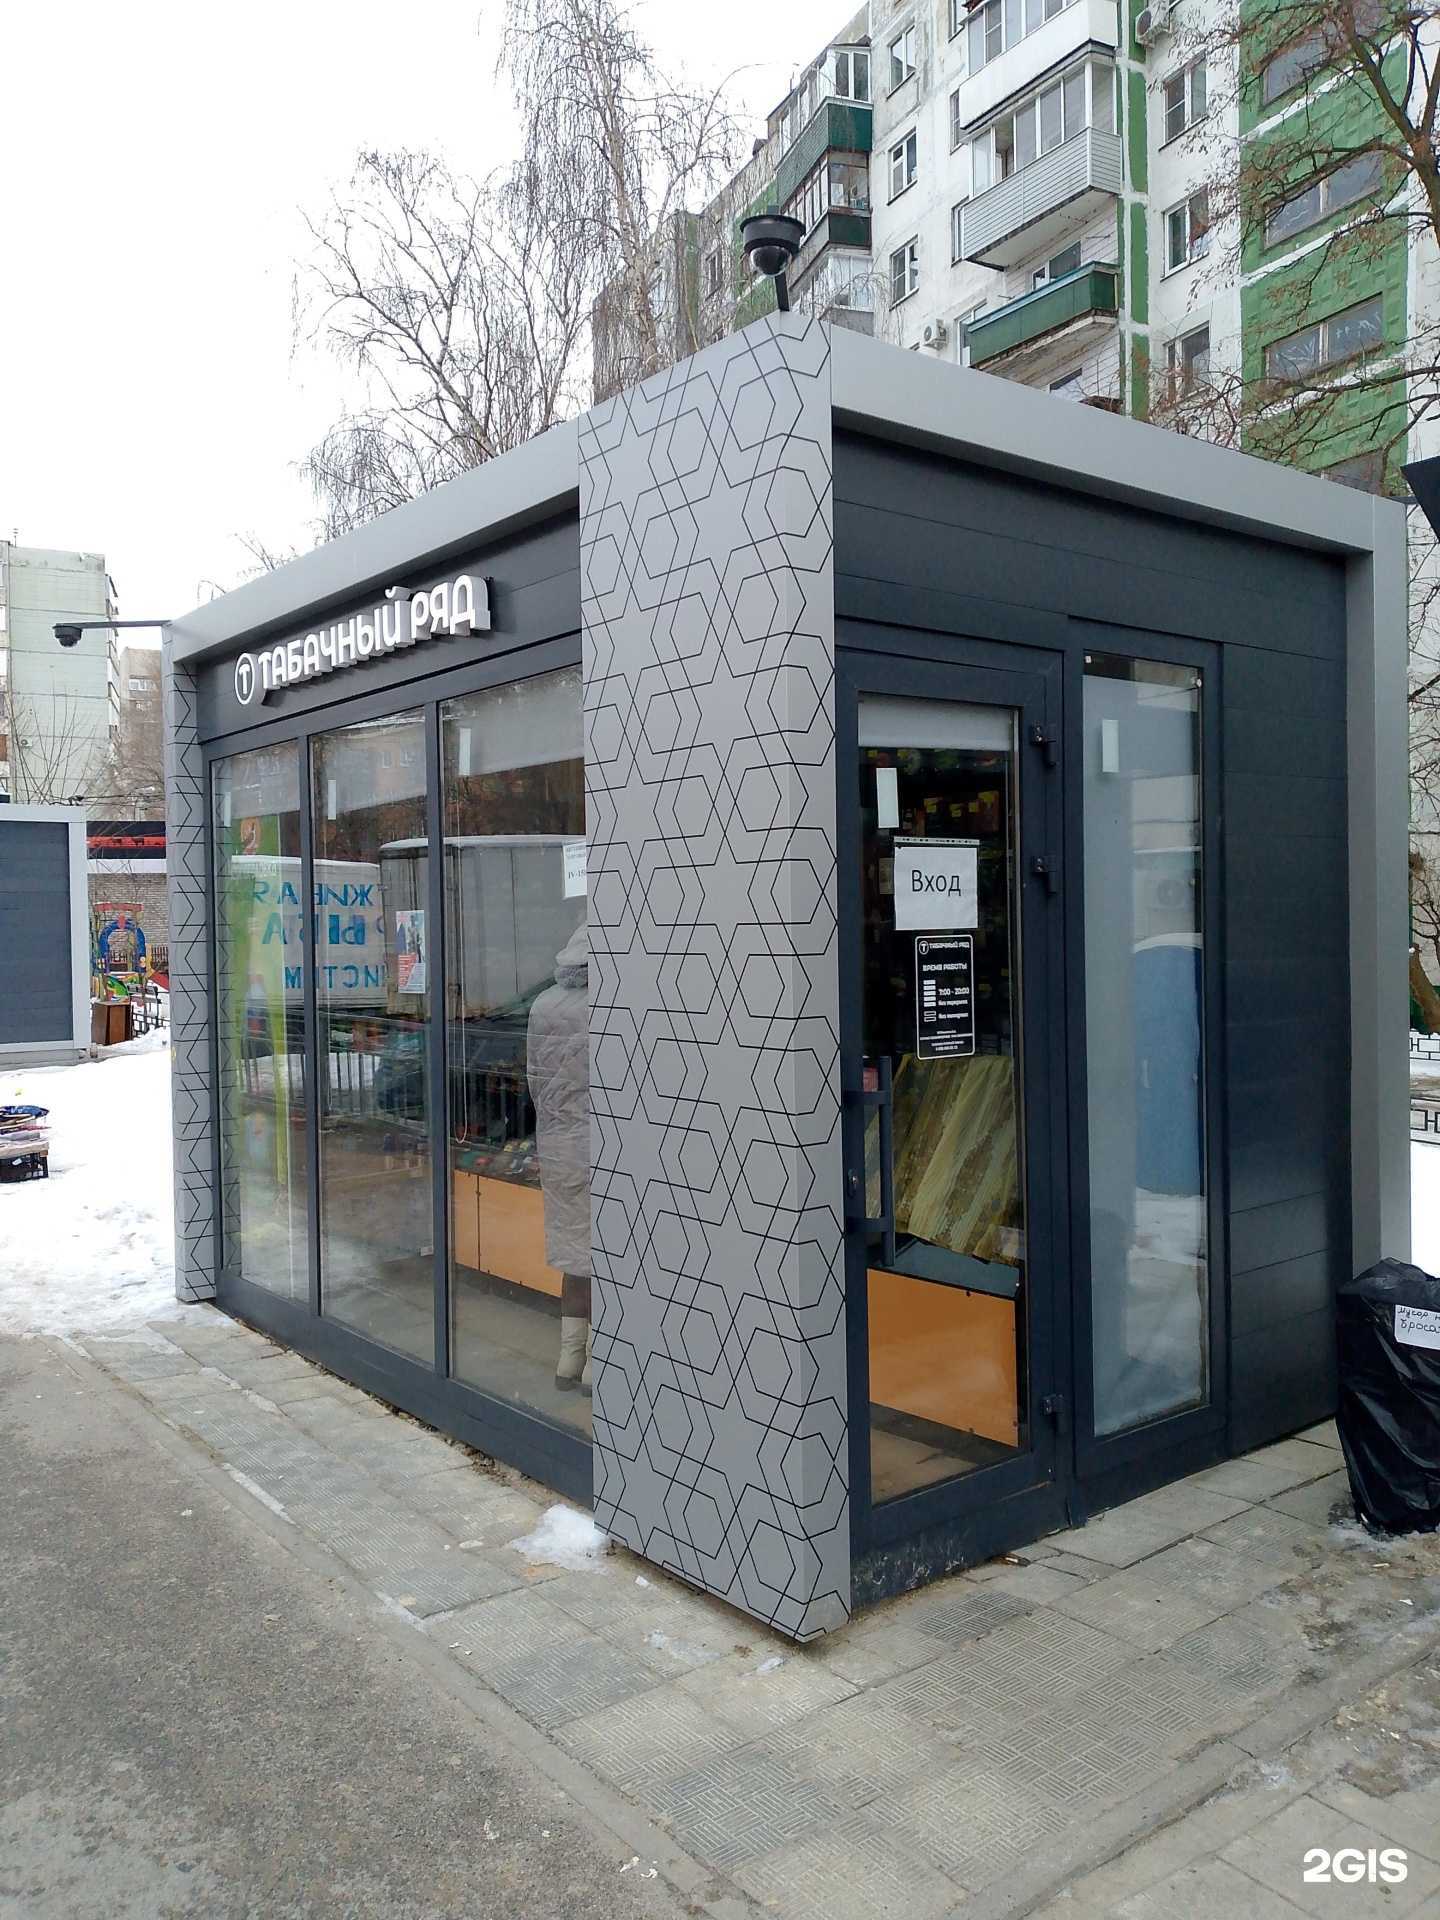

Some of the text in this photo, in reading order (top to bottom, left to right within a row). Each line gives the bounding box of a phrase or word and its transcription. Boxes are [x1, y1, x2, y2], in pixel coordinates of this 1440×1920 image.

[257, 586, 411, 689] ТАБАЧНЫЙ
[411, 574, 488, 640] РЯД
[911, 869, 961, 897] Вход
